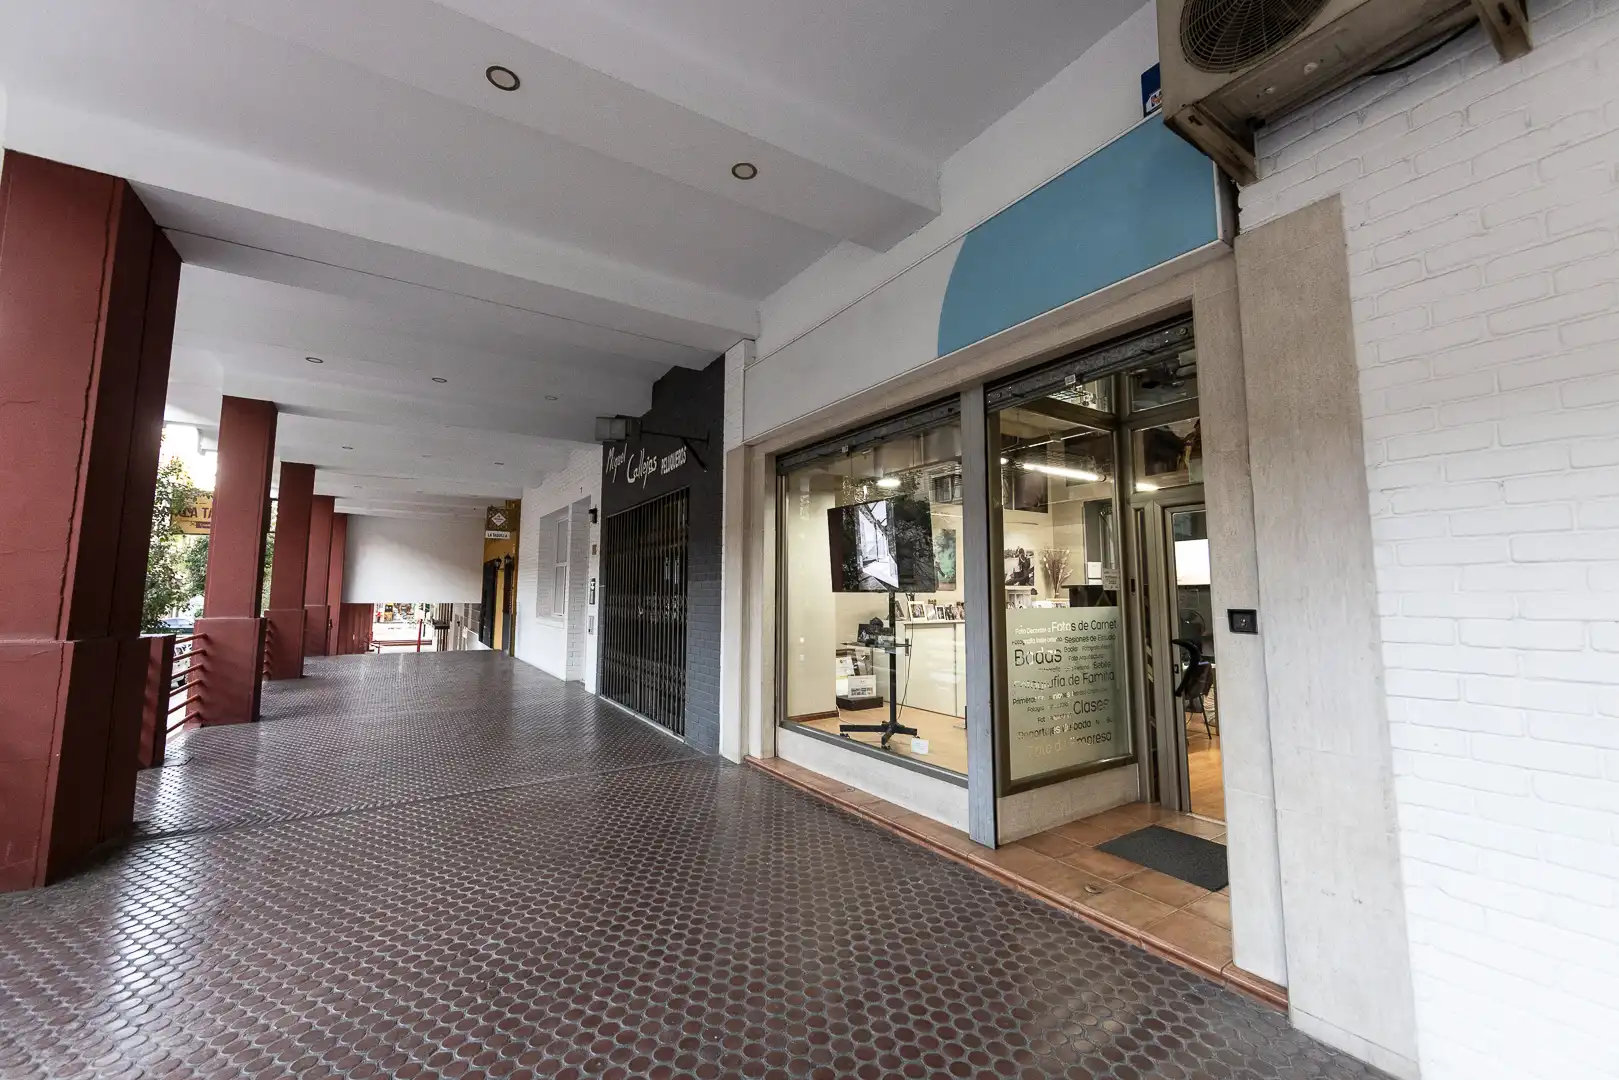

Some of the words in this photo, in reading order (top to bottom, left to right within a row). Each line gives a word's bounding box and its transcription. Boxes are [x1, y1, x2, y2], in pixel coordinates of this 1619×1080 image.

[626, 447, 658, 490] Callejas
[1051, 620, 1077, 633] Fotos
[1078, 620, 1089, 631] de
[1090, 619, 1118, 630] Carnet
[1090, 634, 1097, 642] de
[1014, 646, 1063, 667] Bodas
[1068, 674, 1080, 686] de
[1073, 698, 1110, 715] Clases
